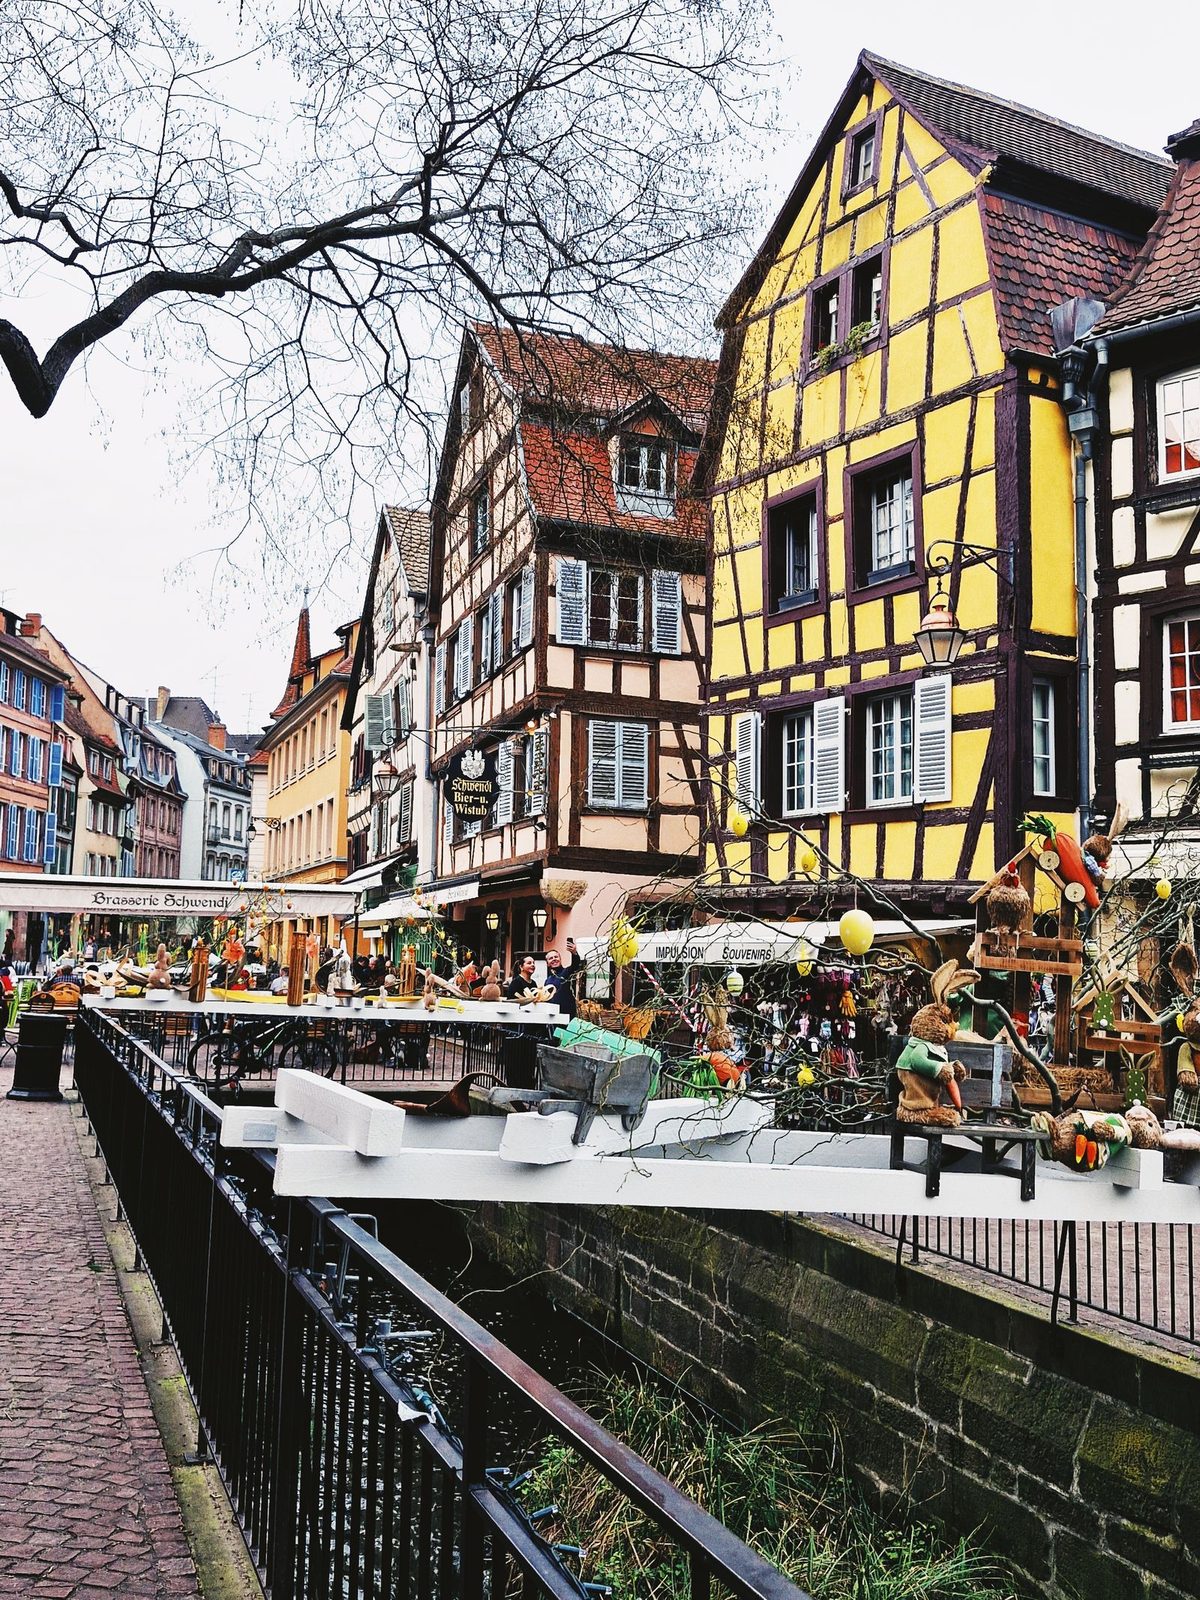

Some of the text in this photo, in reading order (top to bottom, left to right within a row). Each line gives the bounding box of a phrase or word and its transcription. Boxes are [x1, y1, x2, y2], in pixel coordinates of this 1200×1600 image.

[452, 778, 492, 793] Schwendi
[455, 803, 487, 816] Wistub
[91, 891, 229, 909] Brasserie Schwendi
[655, 946, 704, 959] IMPULSION
